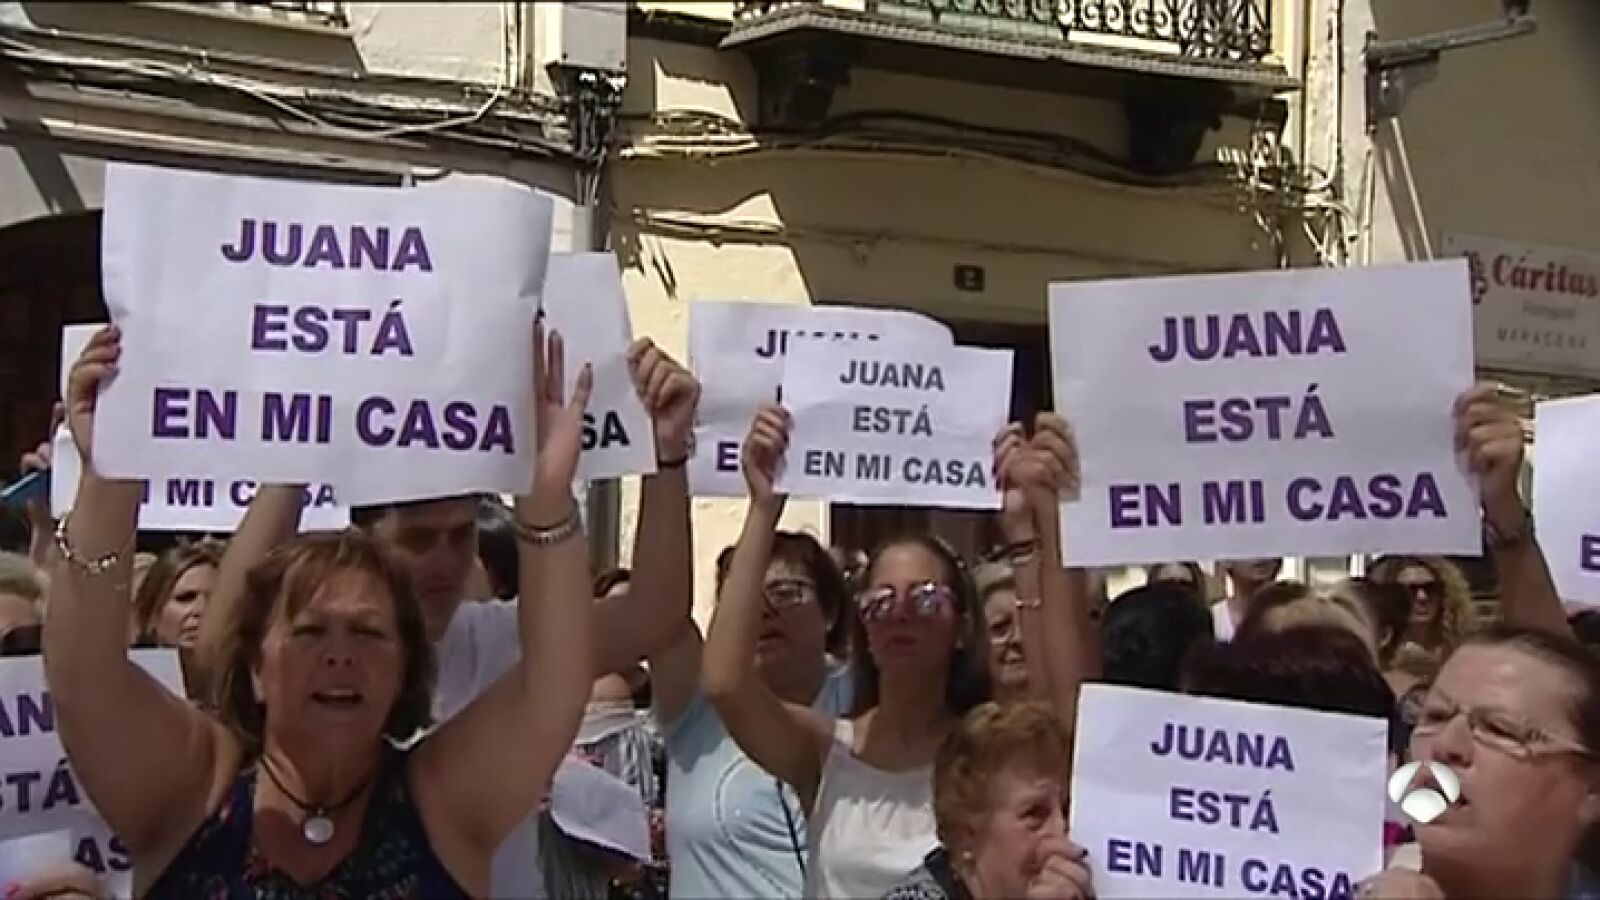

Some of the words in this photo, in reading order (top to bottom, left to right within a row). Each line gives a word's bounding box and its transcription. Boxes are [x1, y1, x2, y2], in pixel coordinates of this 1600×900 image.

[221, 218, 432, 272] JUANA
[251, 300, 414, 356] ESTÁ
[1148, 308, 1346, 364] JUANA
[839, 360, 945, 392] JUANA
[151, 387, 237, 439] EN
[261, 392, 332, 443] MI
[355, 395, 515, 455] CASA
[852, 404, 933, 438] ESTÁ
[1183, 383, 1335, 443] ESTÁ
[166, 478, 214, 506] MI
[804, 450, 846, 478] EN
[855, 453, 892, 482] MI
[902, 457, 986, 488] CASA
[1109, 483, 1182, 529] EN
[1202, 479, 1266, 525] MI
[1286, 472, 1448, 521] CASA
[1150, 723, 1295, 772] JUANA
[1169, 787, 1280, 834] ESTÁ
[1107, 839, 1163, 877] EN
[1178, 849, 1225, 888] MI
[1241, 859, 1353, 899] CASA
